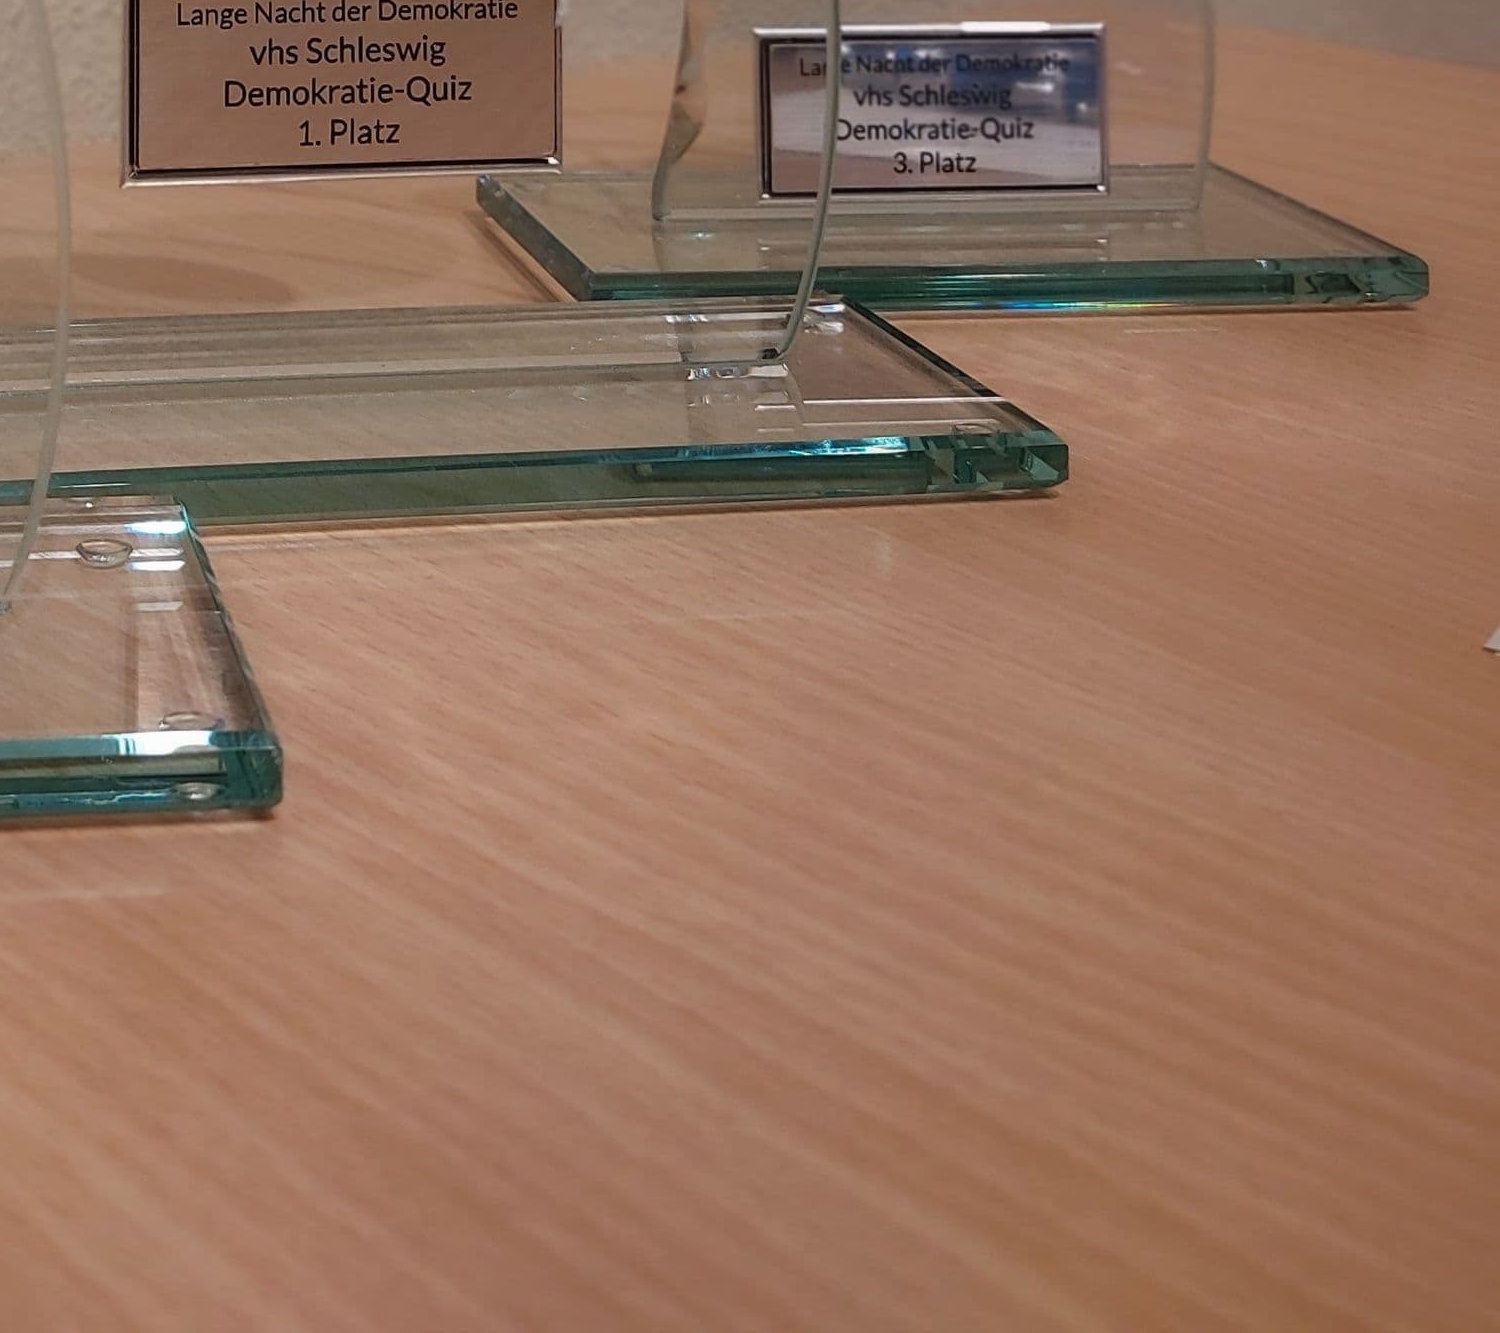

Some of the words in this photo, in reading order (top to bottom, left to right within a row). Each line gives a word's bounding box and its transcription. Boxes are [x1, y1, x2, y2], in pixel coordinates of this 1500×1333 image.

[176, 2, 248, 30] Lange
[254, 0, 326, 25] Nacht
[332, 0, 371, 23] der
[250, 39, 298, 65] vhs
[306, 35, 446, 67] Schleswig
[856, 56, 914, 74] Nacht
[918, 54, 951, 72] der
[955, 53, 1070, 71] Demokratie
[224, 75, 472, 108] Demokratie-Quiz
[854, 86, 893, 106] vhs
[899, 83, 1012, 109] Schleswig
[299, 120, 321, 146] 1.
[330, 118, 400, 145] Platz
[837, 116, 1034, 143] Demokratie-Quiz
[893, 152, 913, 174] 3.
[920, 151, 977, 174] Platz
